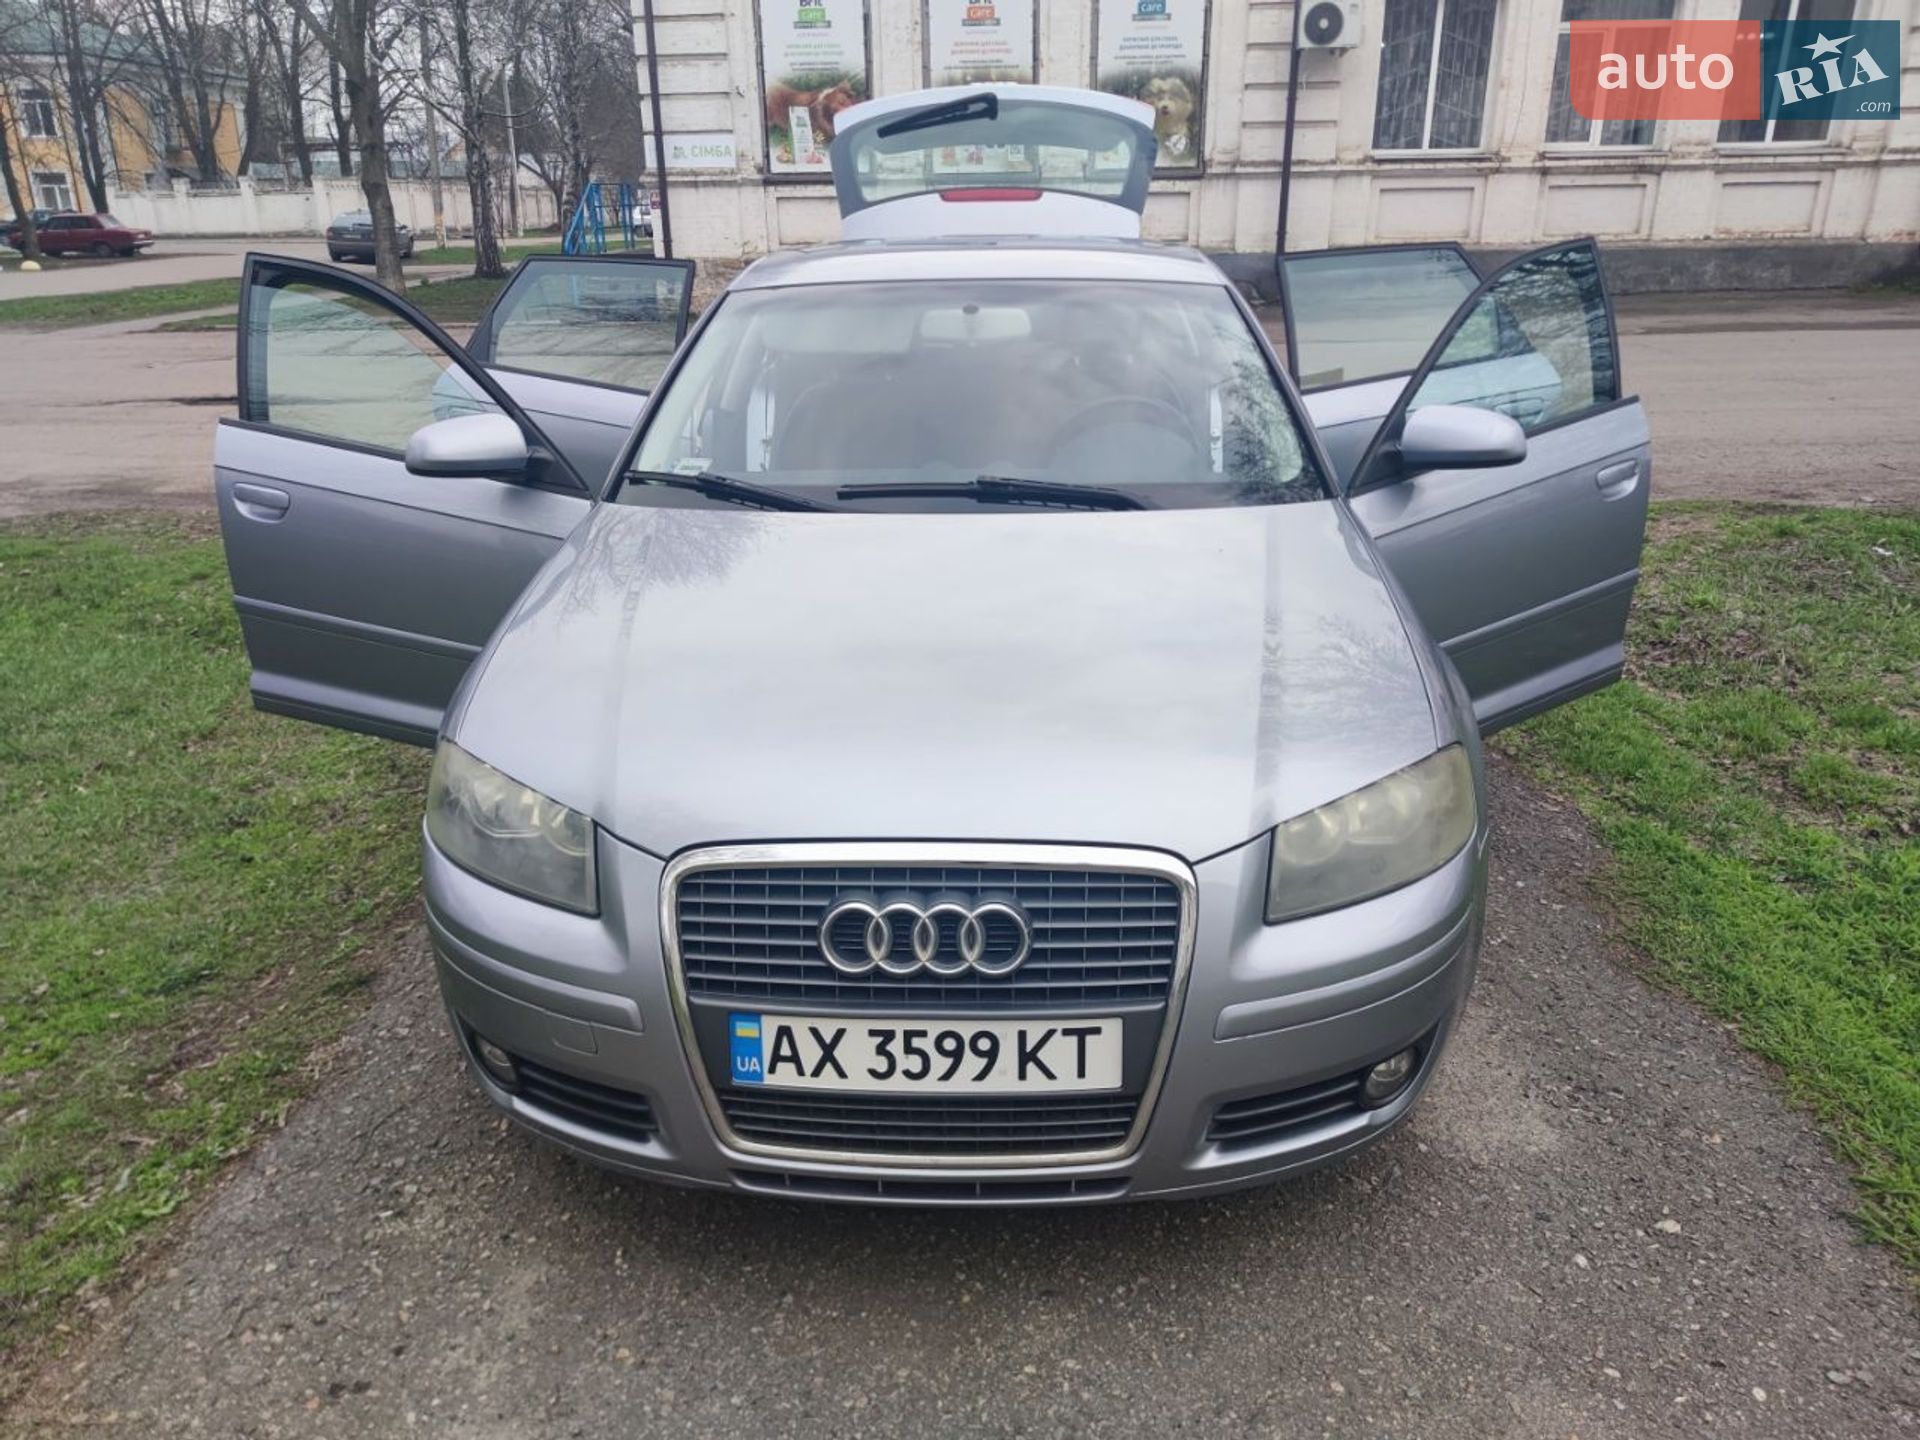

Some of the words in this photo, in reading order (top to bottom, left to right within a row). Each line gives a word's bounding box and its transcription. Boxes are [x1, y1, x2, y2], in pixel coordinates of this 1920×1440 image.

[1141, 3, 1163, 12] care
[767, 1025, 848, 1079] AX
[866, 1028, 1000, 1081] 3599
[1017, 1026, 1102, 1081] KT
[736, 1056, 761, 1073] UA
